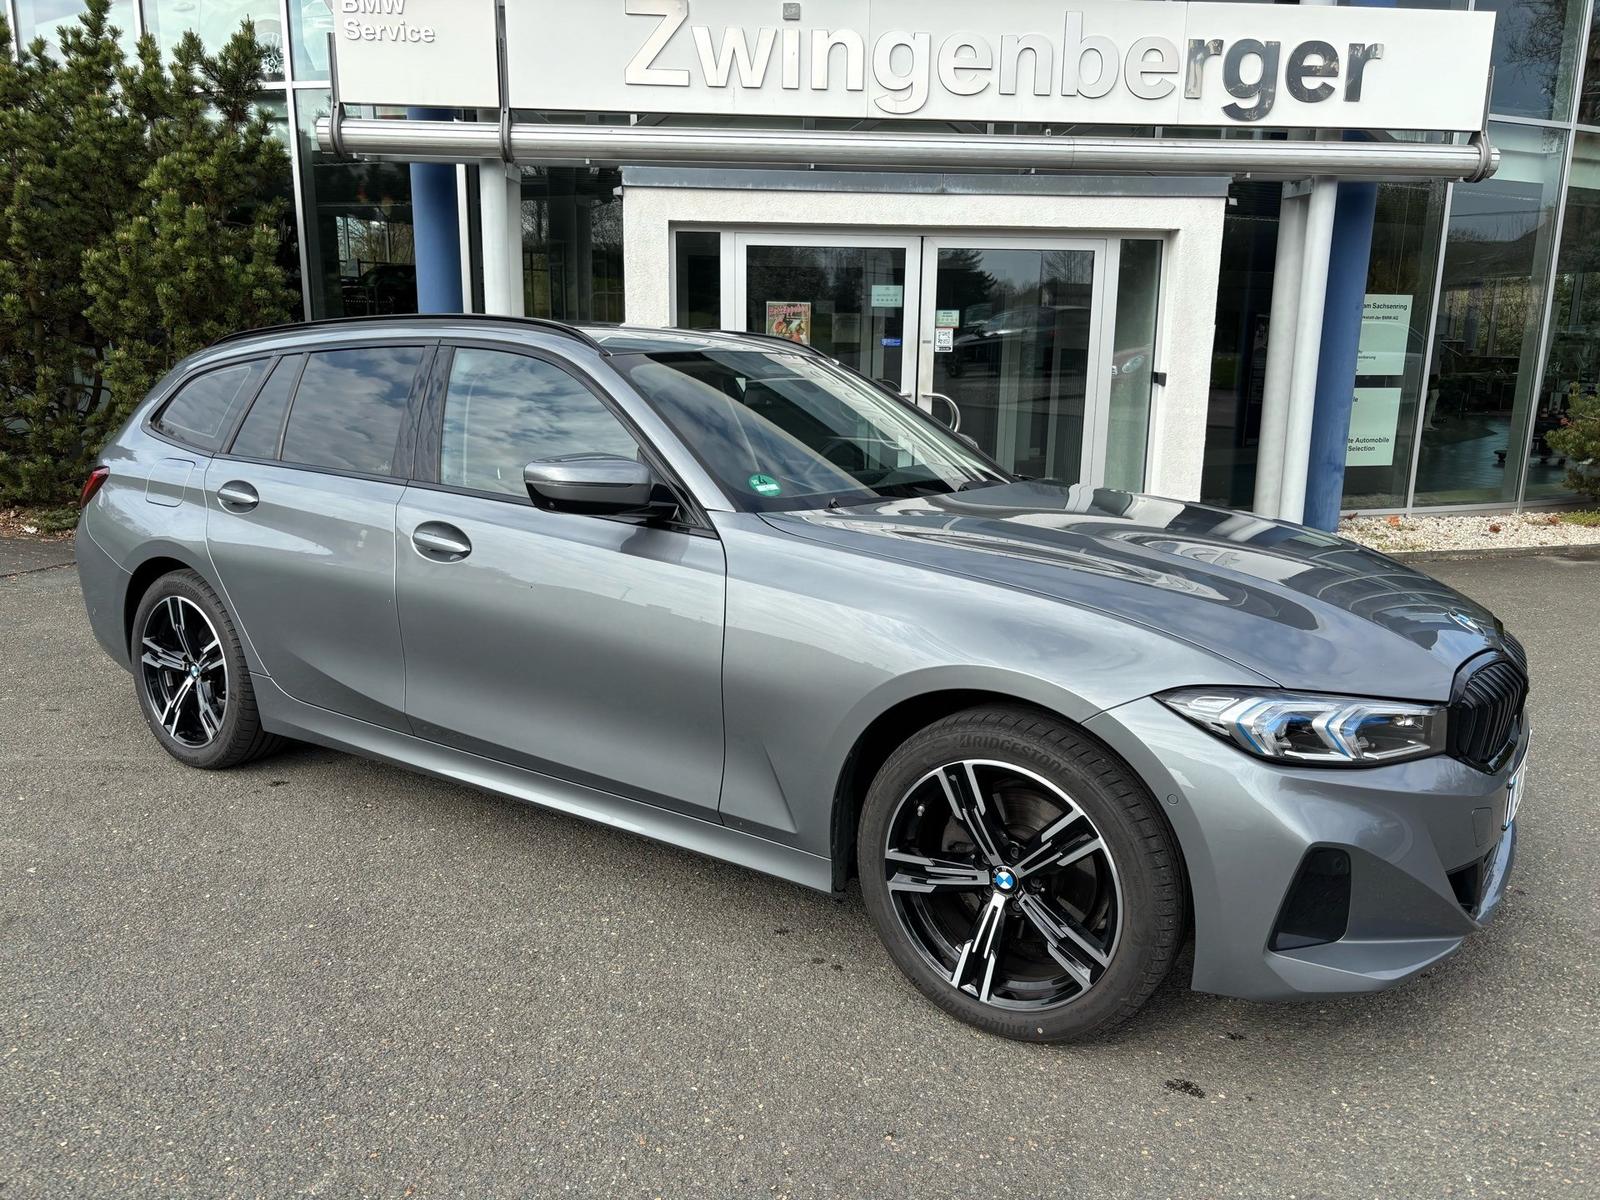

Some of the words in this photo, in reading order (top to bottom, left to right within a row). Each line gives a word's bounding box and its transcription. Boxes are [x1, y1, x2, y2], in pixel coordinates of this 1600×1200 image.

[342, 0, 406, 15] BMW
[343, 17, 436, 43] Service
[624, 0, 1385, 122] Zwingenberger
[1372, 302, 1408, 311] Sachsenring
[959, 733, 1071, 777] BRIDGESTONE
